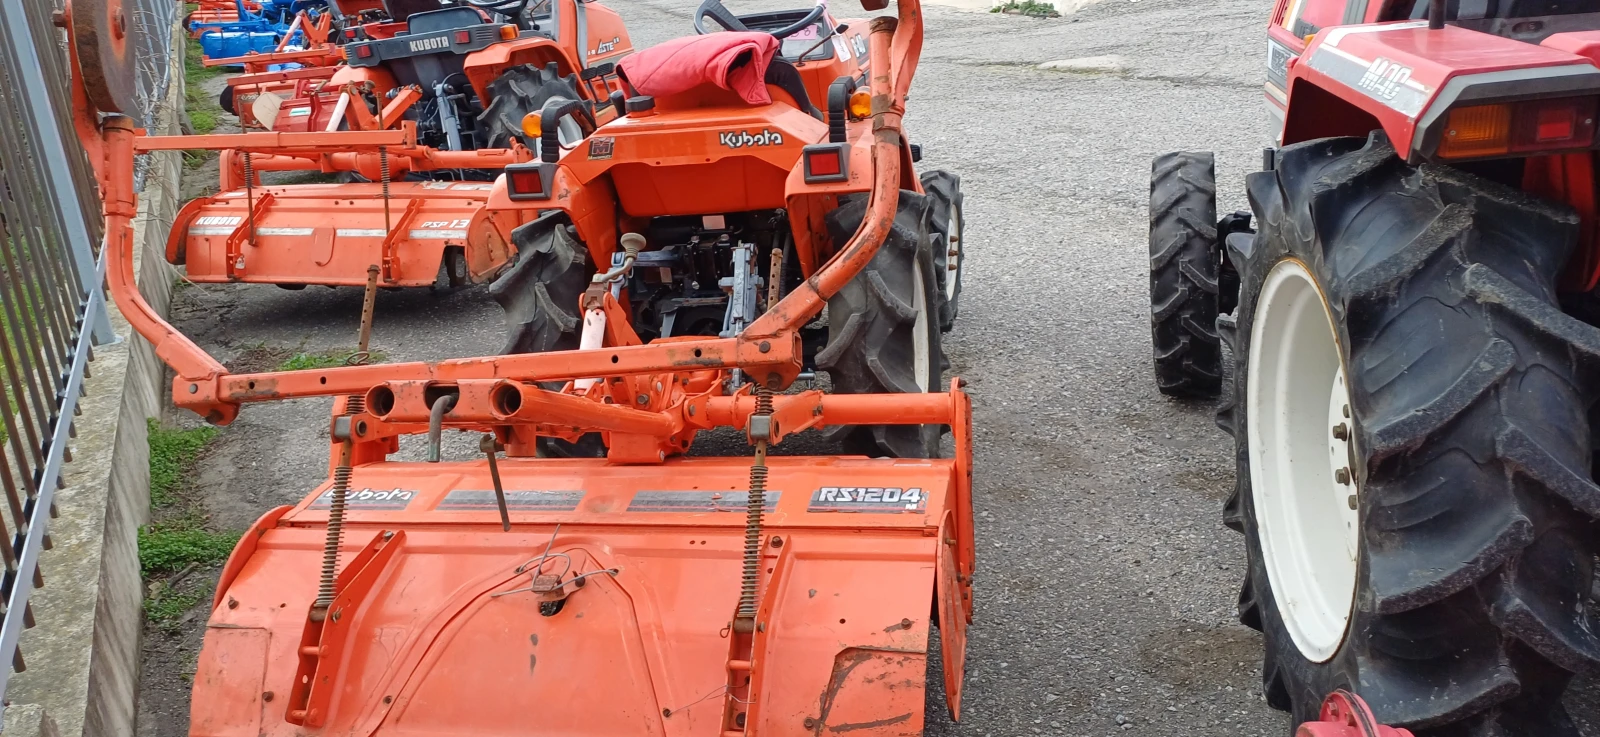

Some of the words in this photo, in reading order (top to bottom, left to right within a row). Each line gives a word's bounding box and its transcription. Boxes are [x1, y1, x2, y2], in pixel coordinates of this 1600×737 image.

[410, 36, 449, 52] KUBOTA
[719, 129, 783, 148] Kubota
[195, 216, 242, 226] KUBOTA
[449, 219, 471, 228] 13
[819, 486, 922, 503] RS1204
